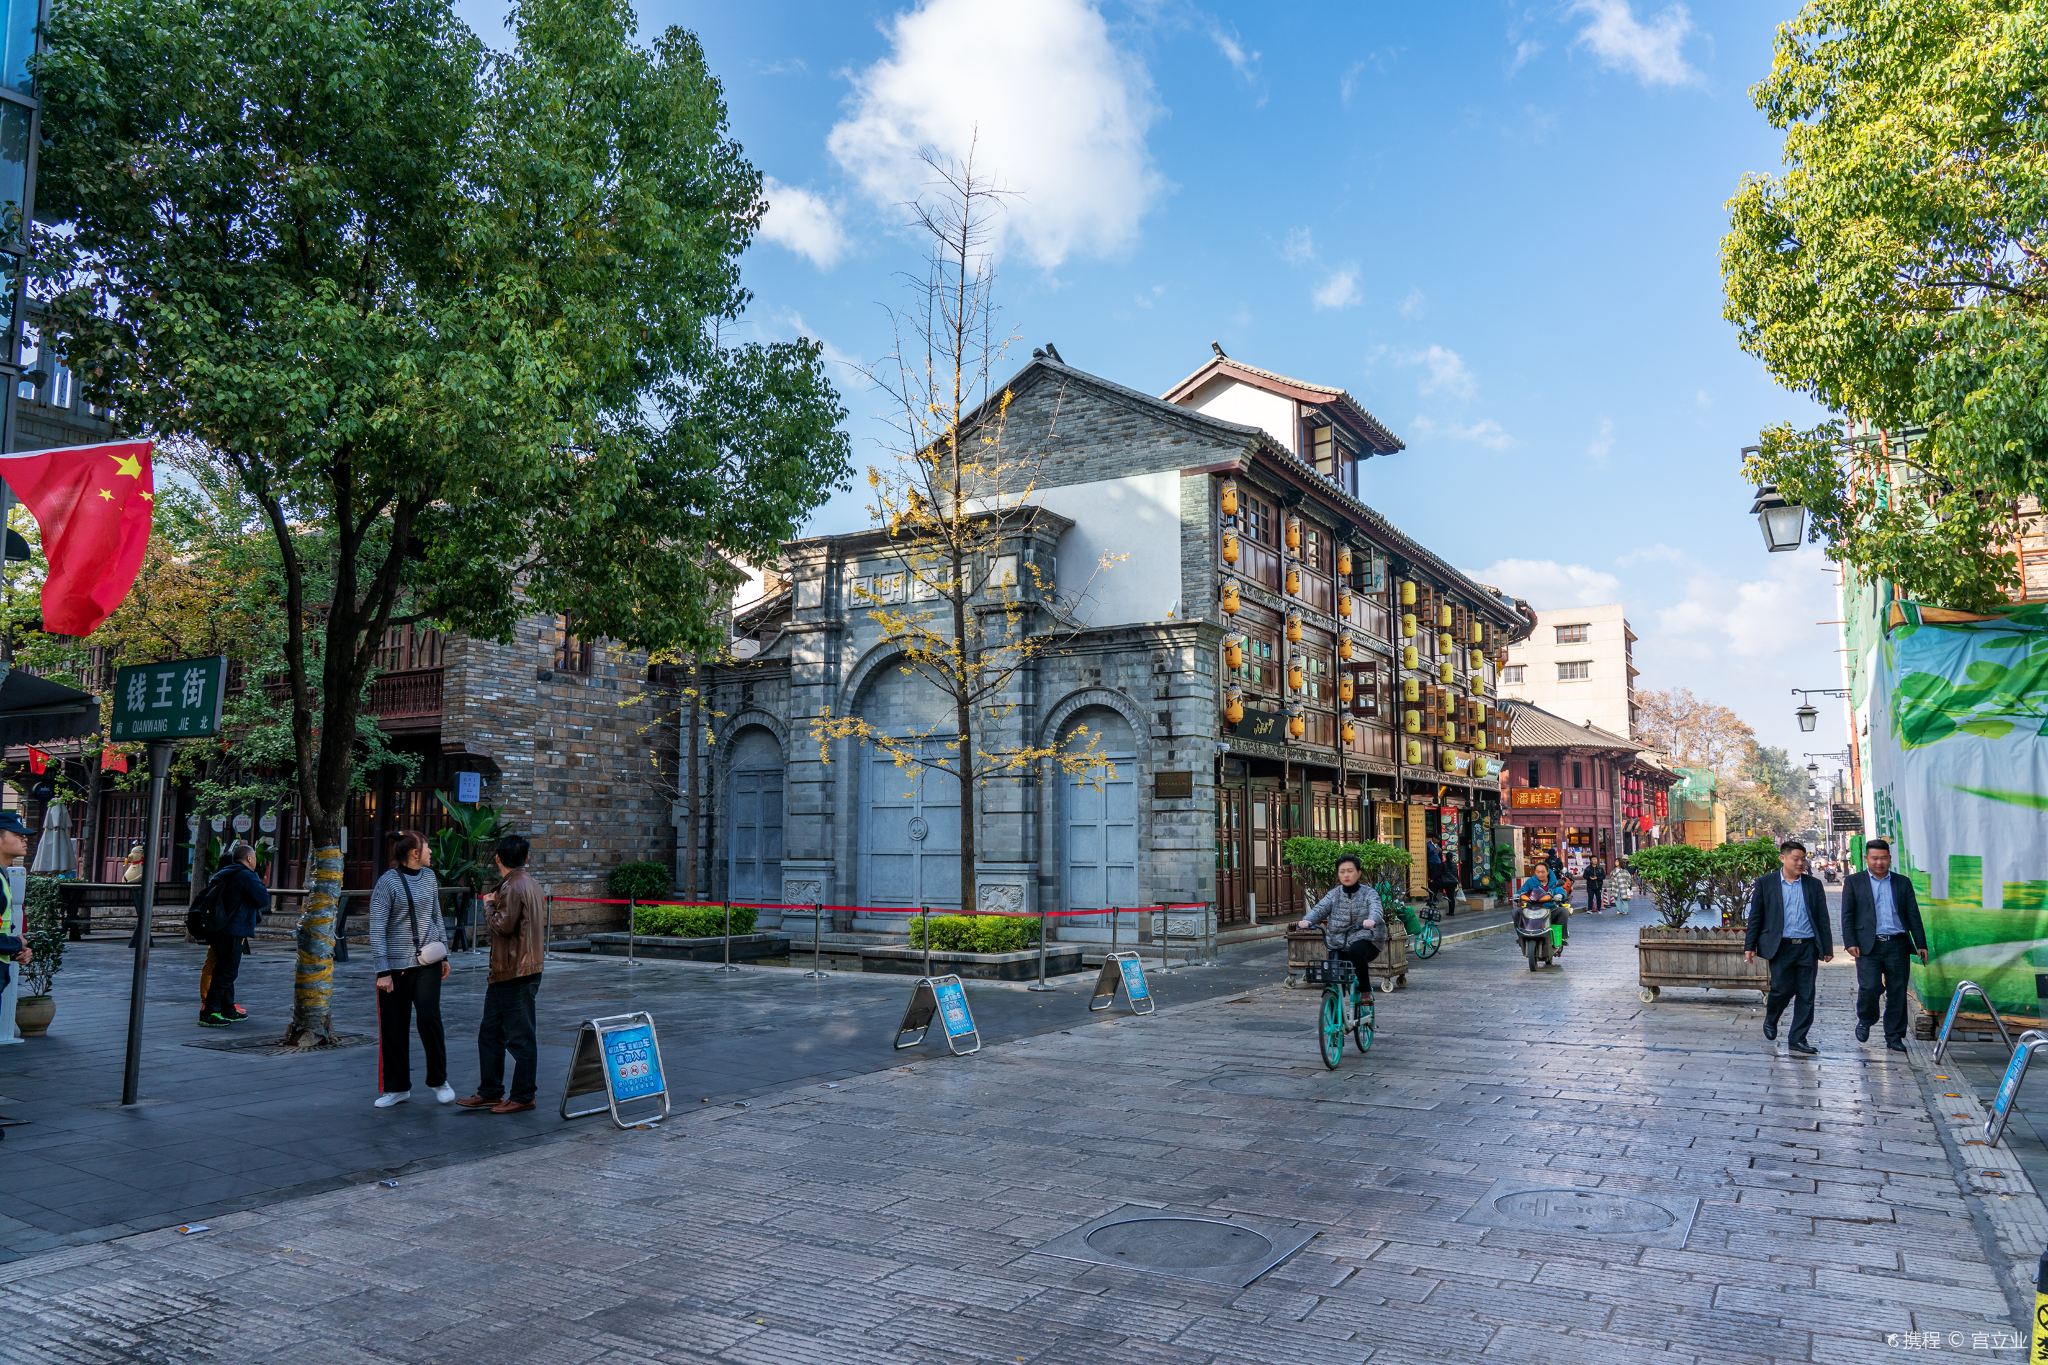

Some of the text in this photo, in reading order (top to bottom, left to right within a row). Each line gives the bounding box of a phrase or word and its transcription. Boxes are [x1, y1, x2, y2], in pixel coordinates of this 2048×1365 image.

[127, 667, 206, 713] 钱王街
[132, 719, 168, 734] QIANWANG
[178, 717, 190, 731] JIE
[200, 715, 208, 730] 北
